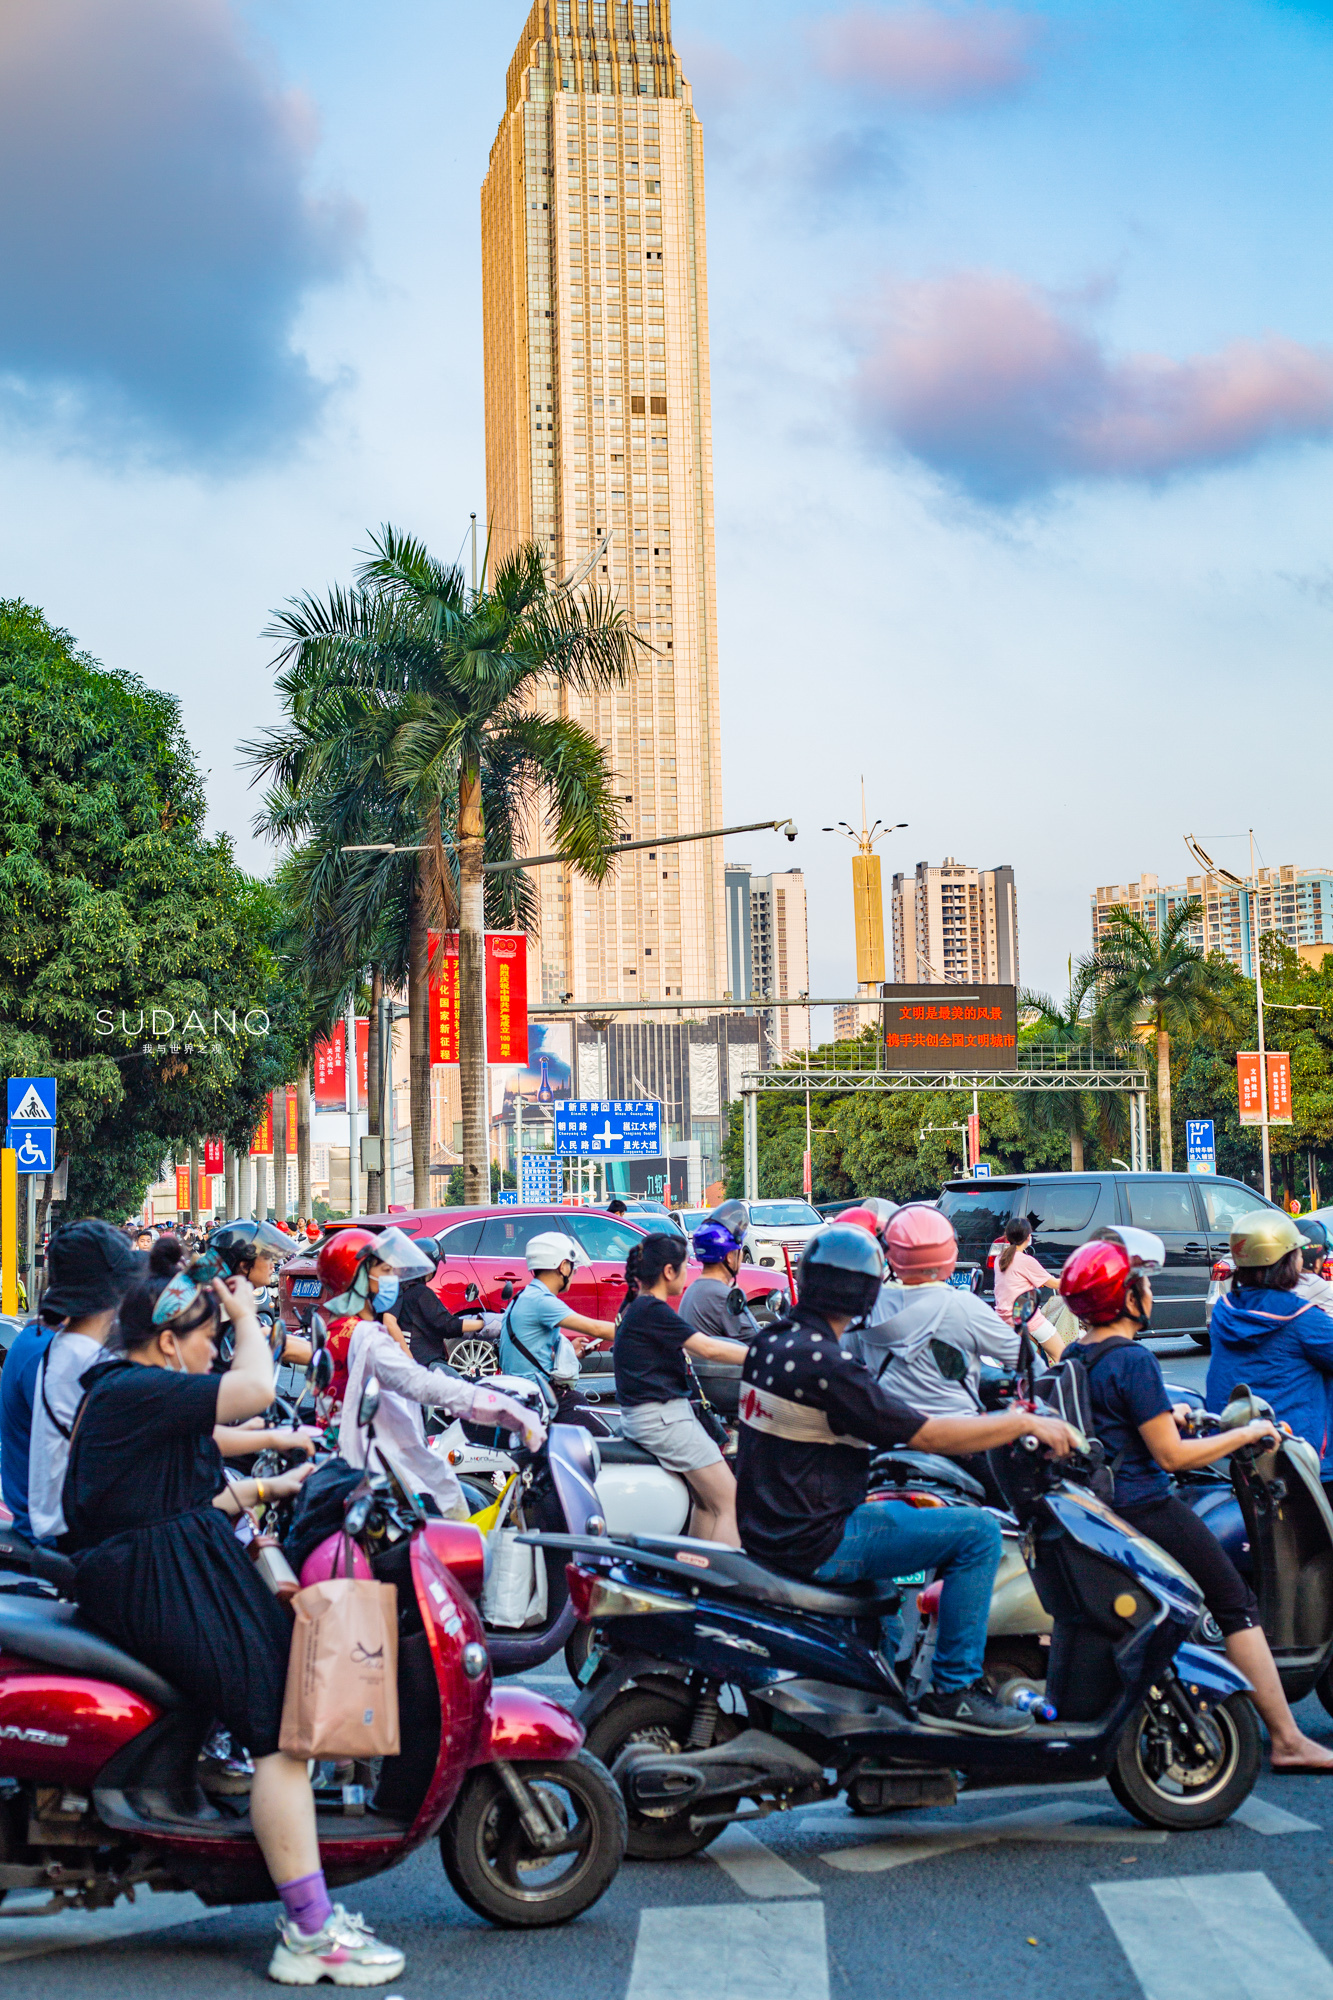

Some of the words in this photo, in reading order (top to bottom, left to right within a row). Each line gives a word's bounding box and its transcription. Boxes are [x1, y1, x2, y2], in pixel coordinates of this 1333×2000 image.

[899, 1006, 1003, 1020] 文明是最美的风景
[886, 1032, 1016, 1048] 携手共创全国文明城市
[1250, 1068, 1258, 1098] 文明健康
[1243, 1078, 1251, 1108] 绿色环保
[568, 1103, 599, 1112] 新民路
[614, 1103, 654, 1112] 民族广场
[558, 1121, 588, 1131] 朝阳路
[623, 1121, 657, 1131] 邕江大桥
[558, 1140, 589, 1150] 人民路
[623, 1140, 657, 1150] 星光大道
